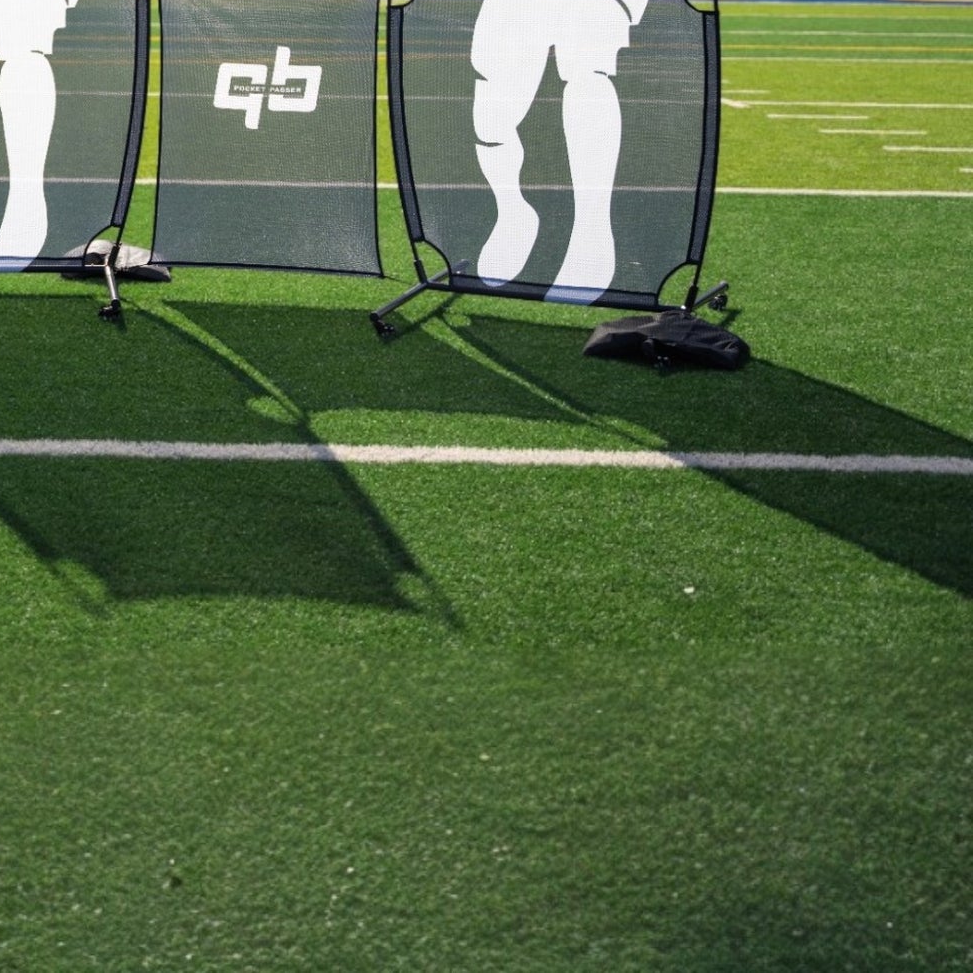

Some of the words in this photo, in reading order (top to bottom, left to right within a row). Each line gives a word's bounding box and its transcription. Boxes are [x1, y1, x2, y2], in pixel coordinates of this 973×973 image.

[214, 46, 322, 129] qb
[233, 84, 266, 92] POCKET
[269, 86, 302, 94] PASSER
